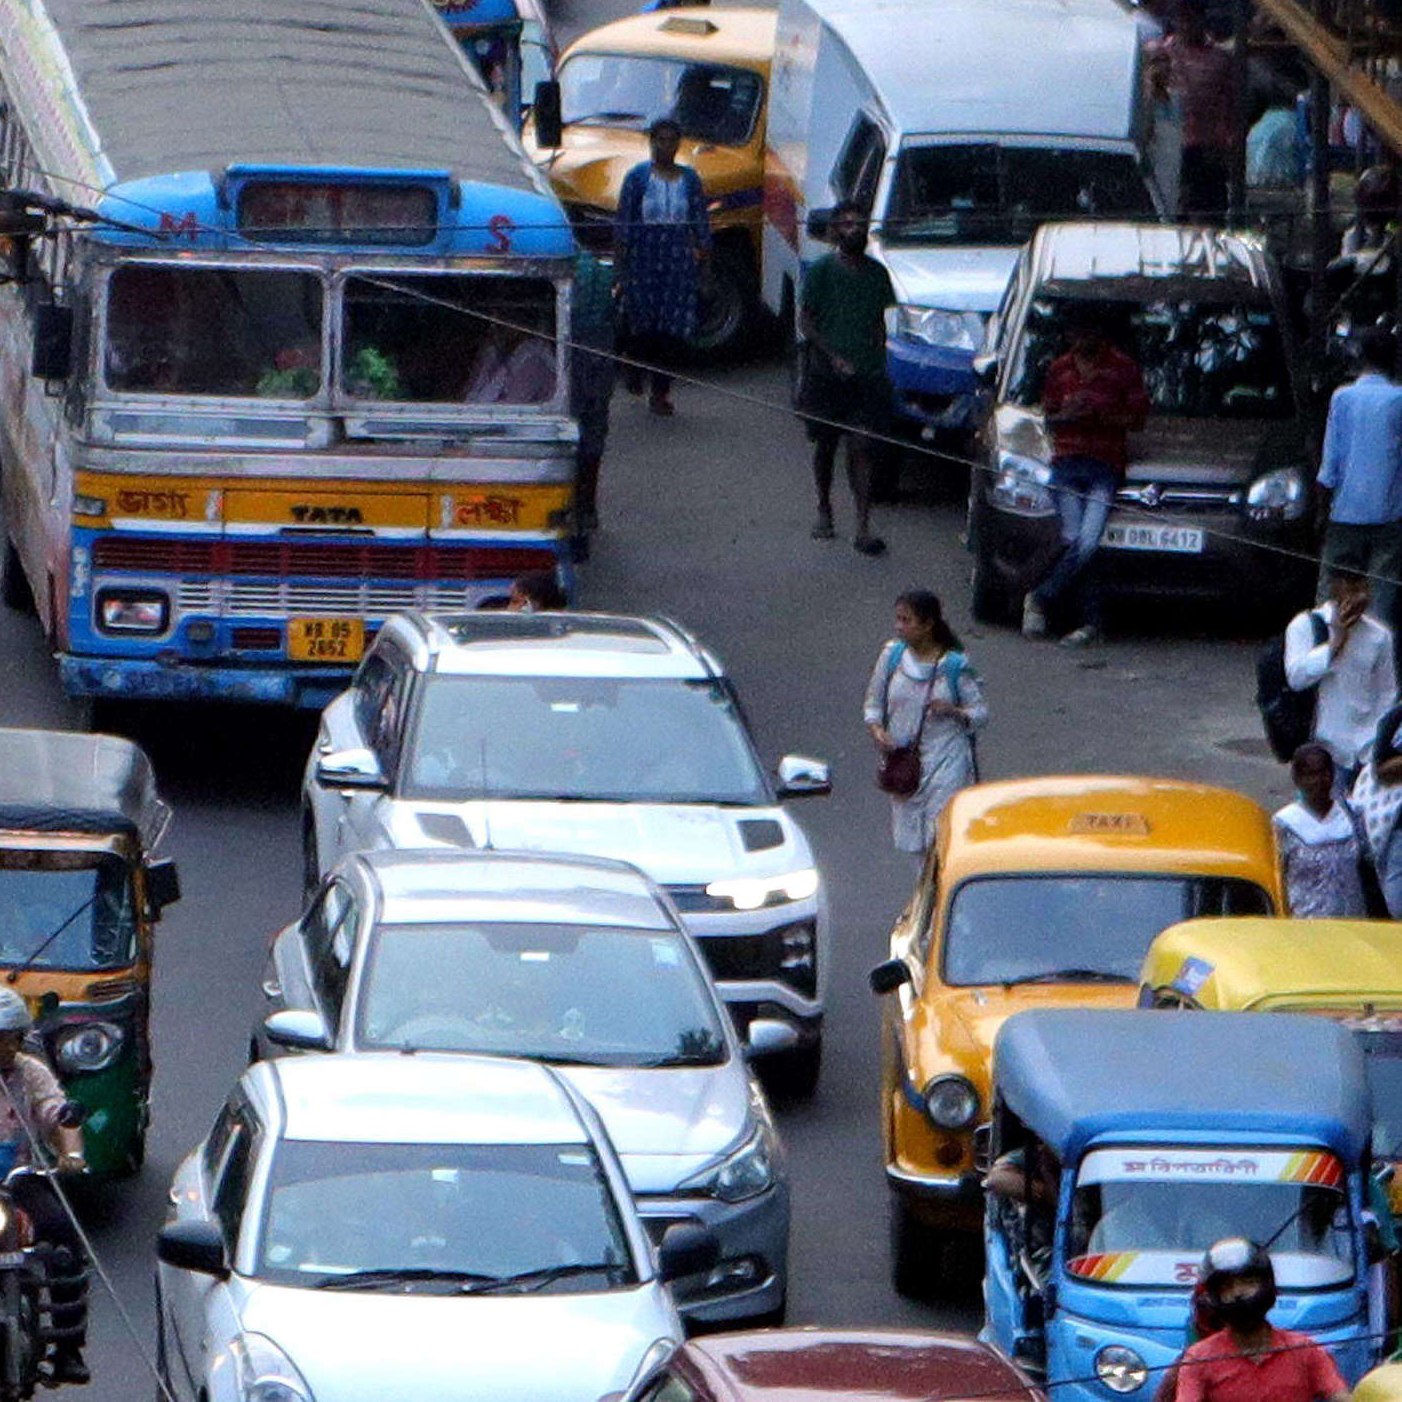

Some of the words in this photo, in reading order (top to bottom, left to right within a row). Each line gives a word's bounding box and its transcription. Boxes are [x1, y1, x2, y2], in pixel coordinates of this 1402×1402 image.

[159, 212, 196, 241] M
[485, 214, 512, 253] S
[291, 505, 364, 525] TATA
